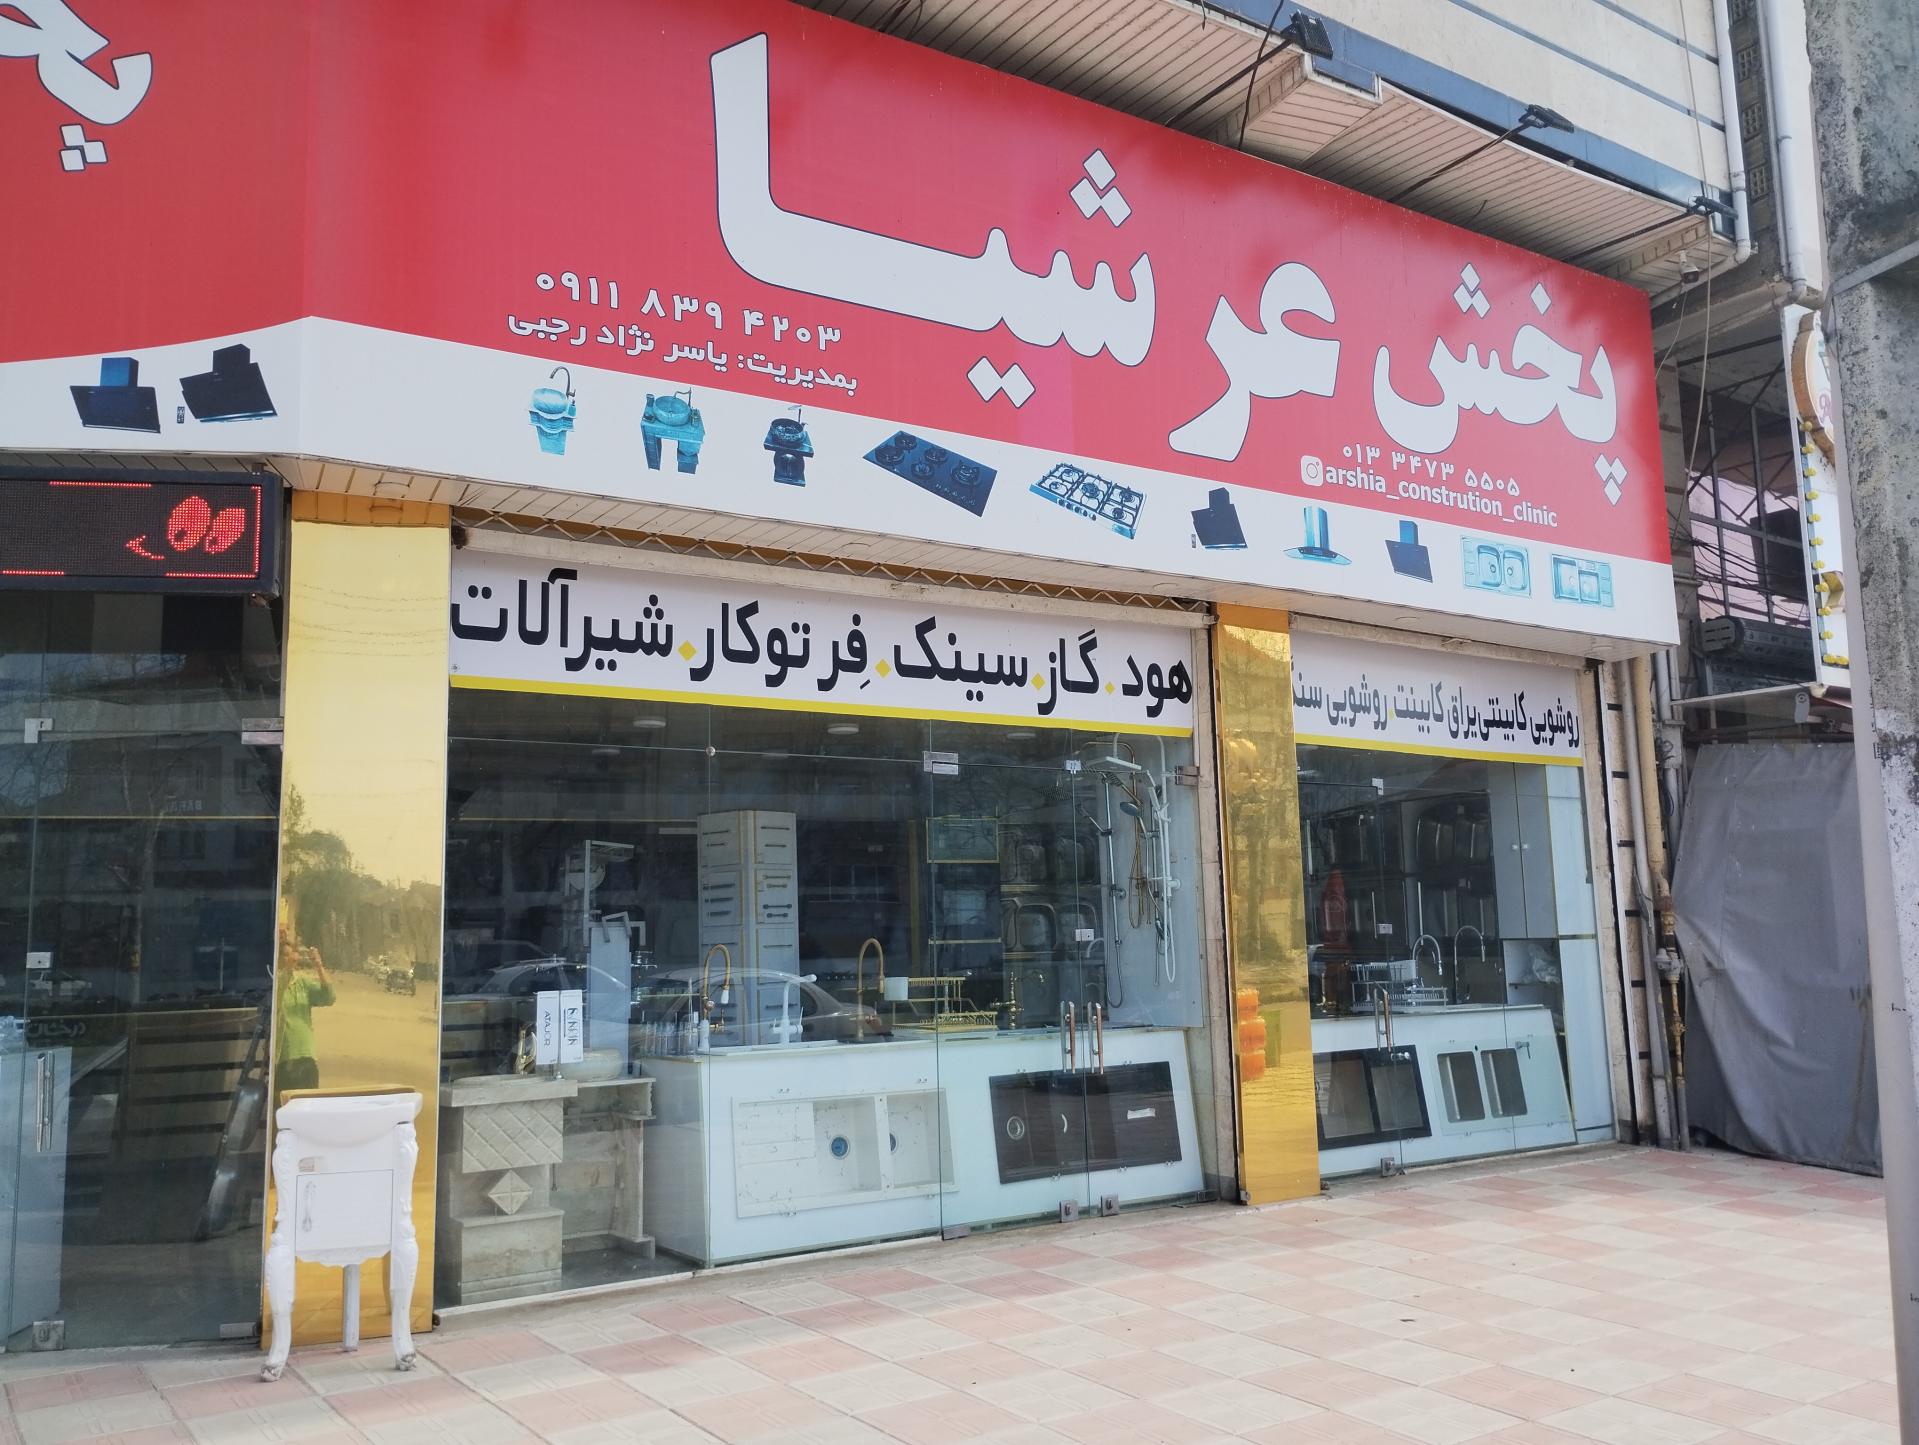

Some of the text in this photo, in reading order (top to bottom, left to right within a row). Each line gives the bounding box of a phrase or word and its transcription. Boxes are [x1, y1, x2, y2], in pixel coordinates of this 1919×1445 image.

[710, 32, 1631, 509] پخش عرشیا
[536, 271, 841, 351] ۰۹۱۱ ۸۳۹ ۴۲۰۳
[508, 315, 858, 397] بمدیریت: یاسر نژاد رجبی
[1325, 465, 1559, 528] arshia_constrution_clinic
[1342, 443, 1520, 497] ۰۱۳ ۳۴۷۳ ۵۵۰۵
[689, 599, 811, 688] توکار
[893, 615, 1028, 702] سینک
[1037, 628, 1100, 716] گاز
[1121, 654, 1194, 719] هود
[1326, 673, 1388, 731] روشویی
[1393, 681, 1444, 734] کابینت
[1447, 686, 1477, 740] یراق
[1478, 690, 1526, 742] کابینتی
[1530, 697, 1580, 748] روشویی
